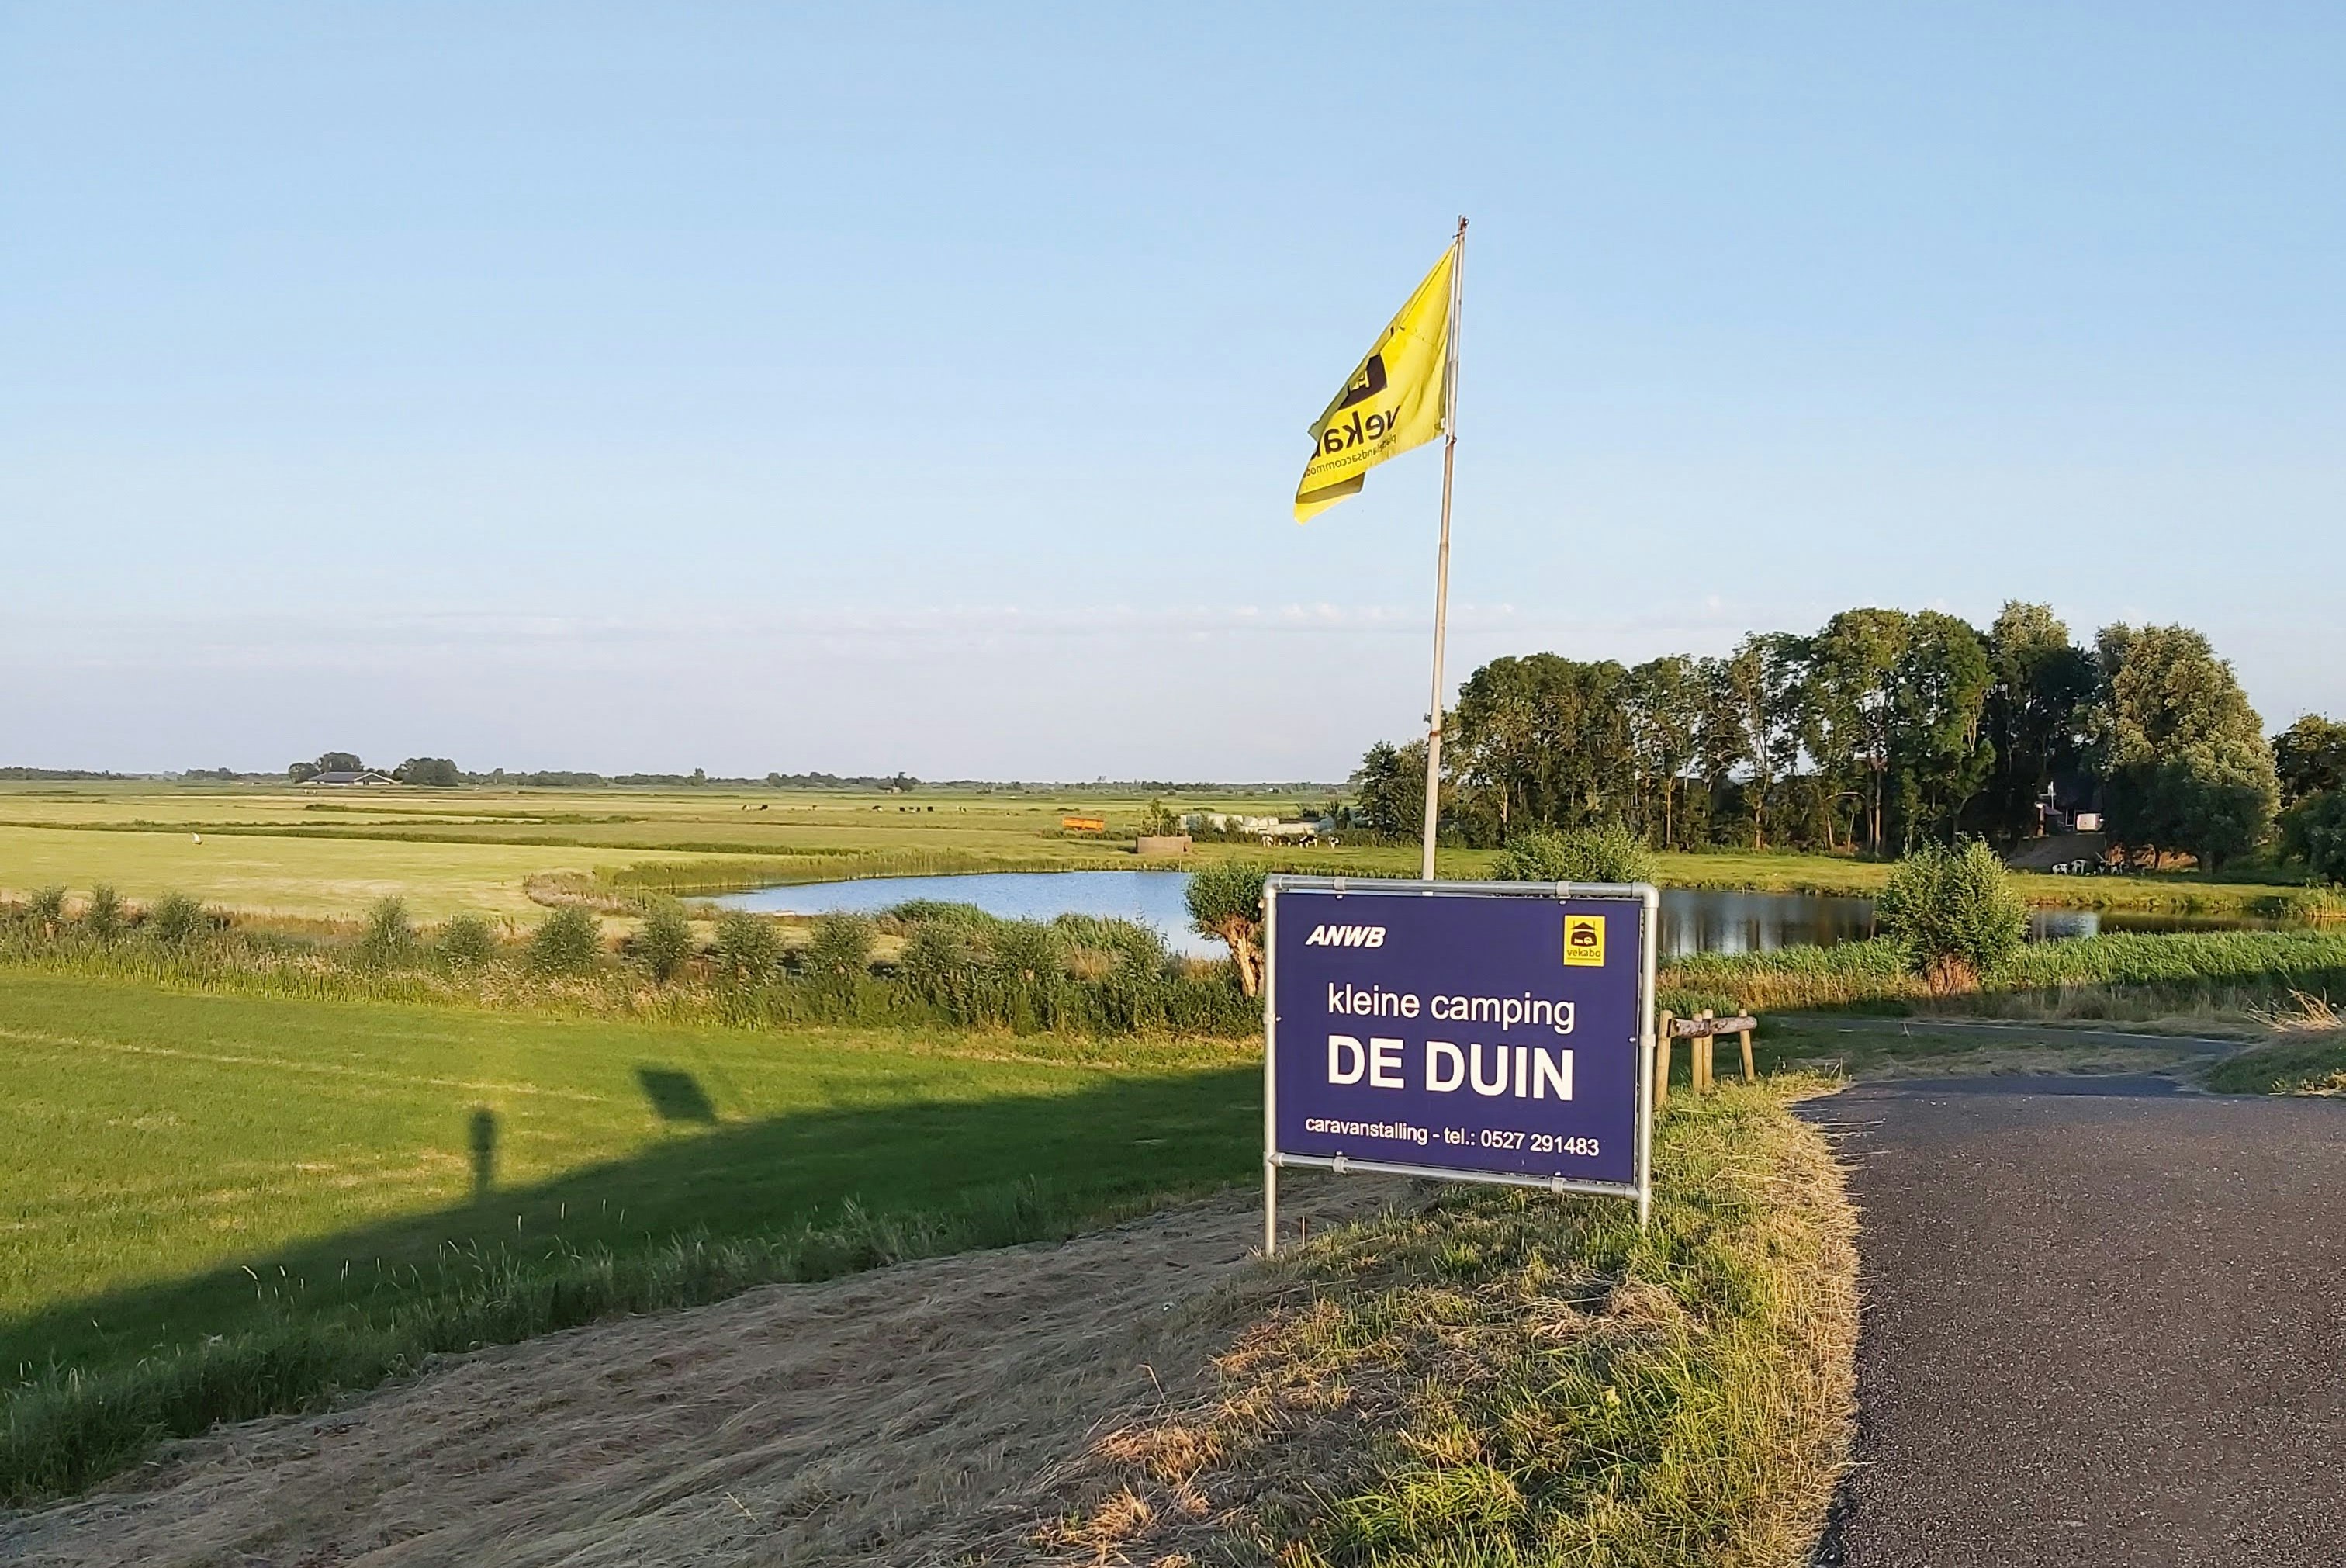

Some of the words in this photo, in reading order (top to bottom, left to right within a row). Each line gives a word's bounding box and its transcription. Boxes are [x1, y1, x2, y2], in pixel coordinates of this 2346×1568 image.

[1305, 925, 1386, 947] ANWB
[1566, 947, 1601, 957] vekabo
[1328, 982, 1420, 1018] kleine
[1431, 992, 1575, 1035] camping
[1328, 1034, 1404, 1089] DE
[1425, 1040, 1573, 1101] DUIN
[1305, 1118, 1428, 1146] caravanstalling
[1444, 1127, 1476, 1146] tel.:
[1480, 1130, 1526, 1150] 0527
[1530, 1134, 1600, 1157] 291483
